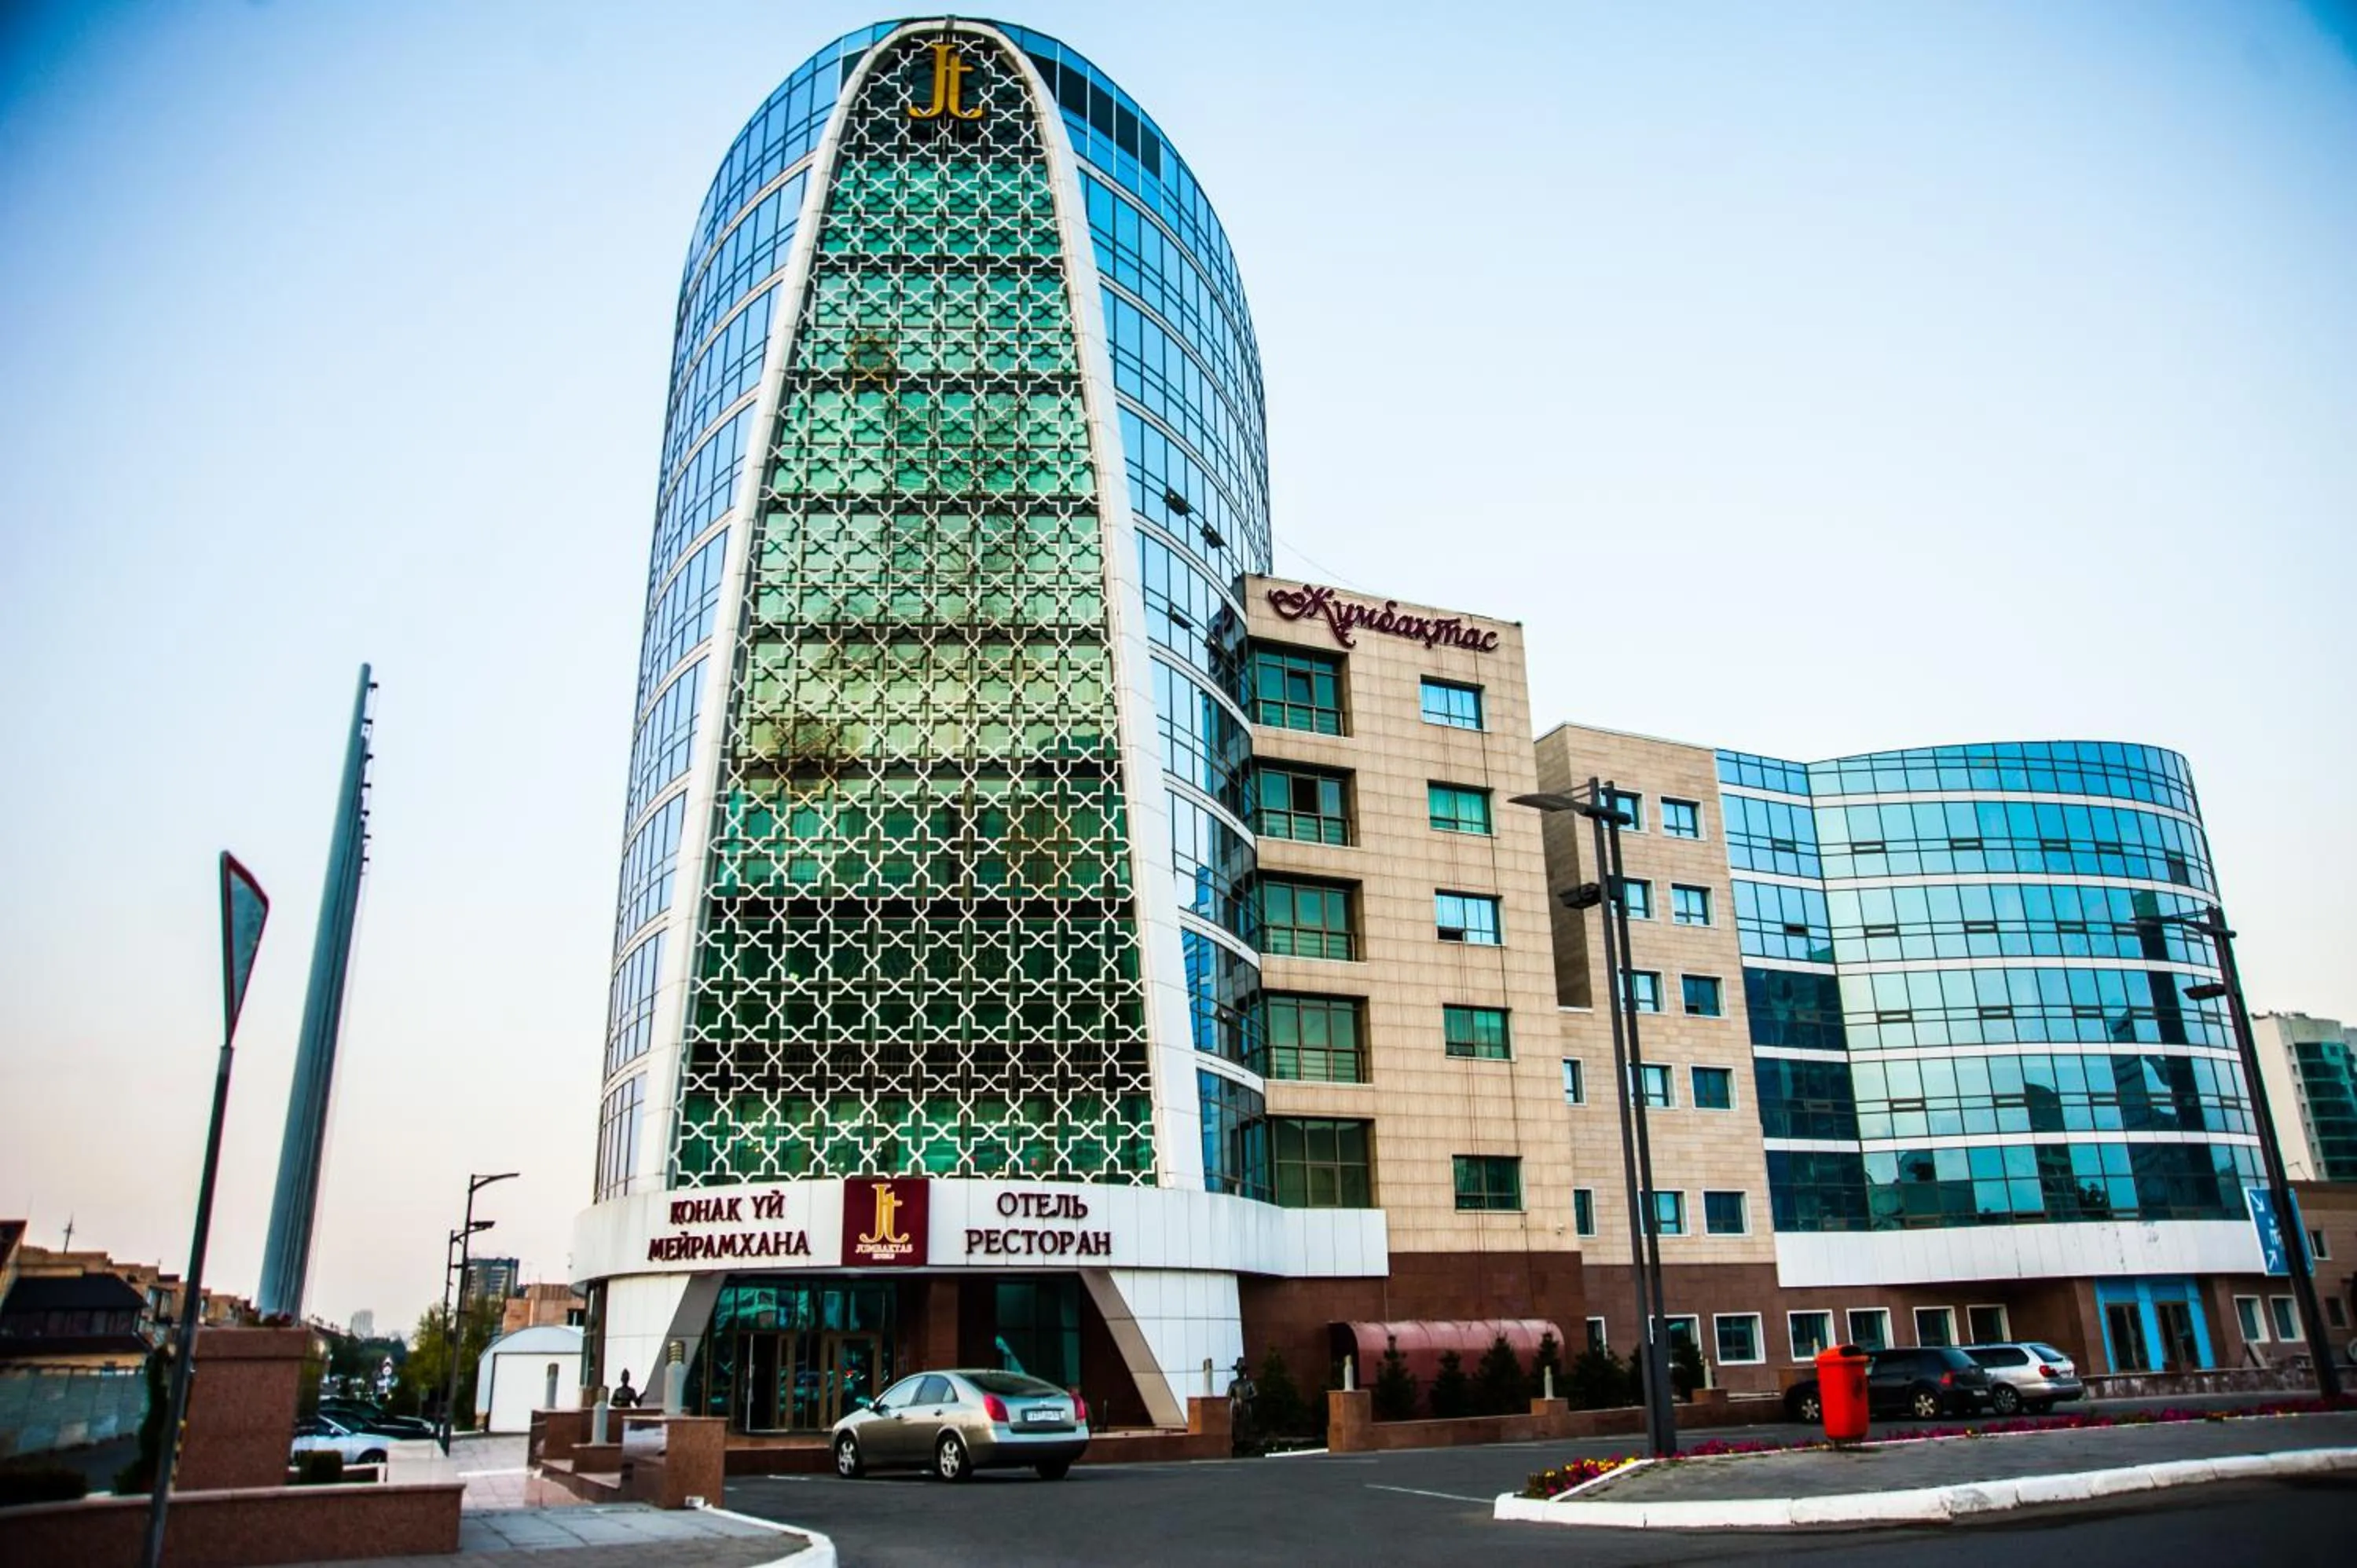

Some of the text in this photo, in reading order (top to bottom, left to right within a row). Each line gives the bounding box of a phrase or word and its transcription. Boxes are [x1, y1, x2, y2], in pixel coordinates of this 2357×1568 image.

[997, 1192, 1089, 1219] ОТЕЛЬ
[647, 1229, 812, 1261] МЕЙРАМХАНА
[965, 1229, 1112, 1256] РЕСТОРАН
